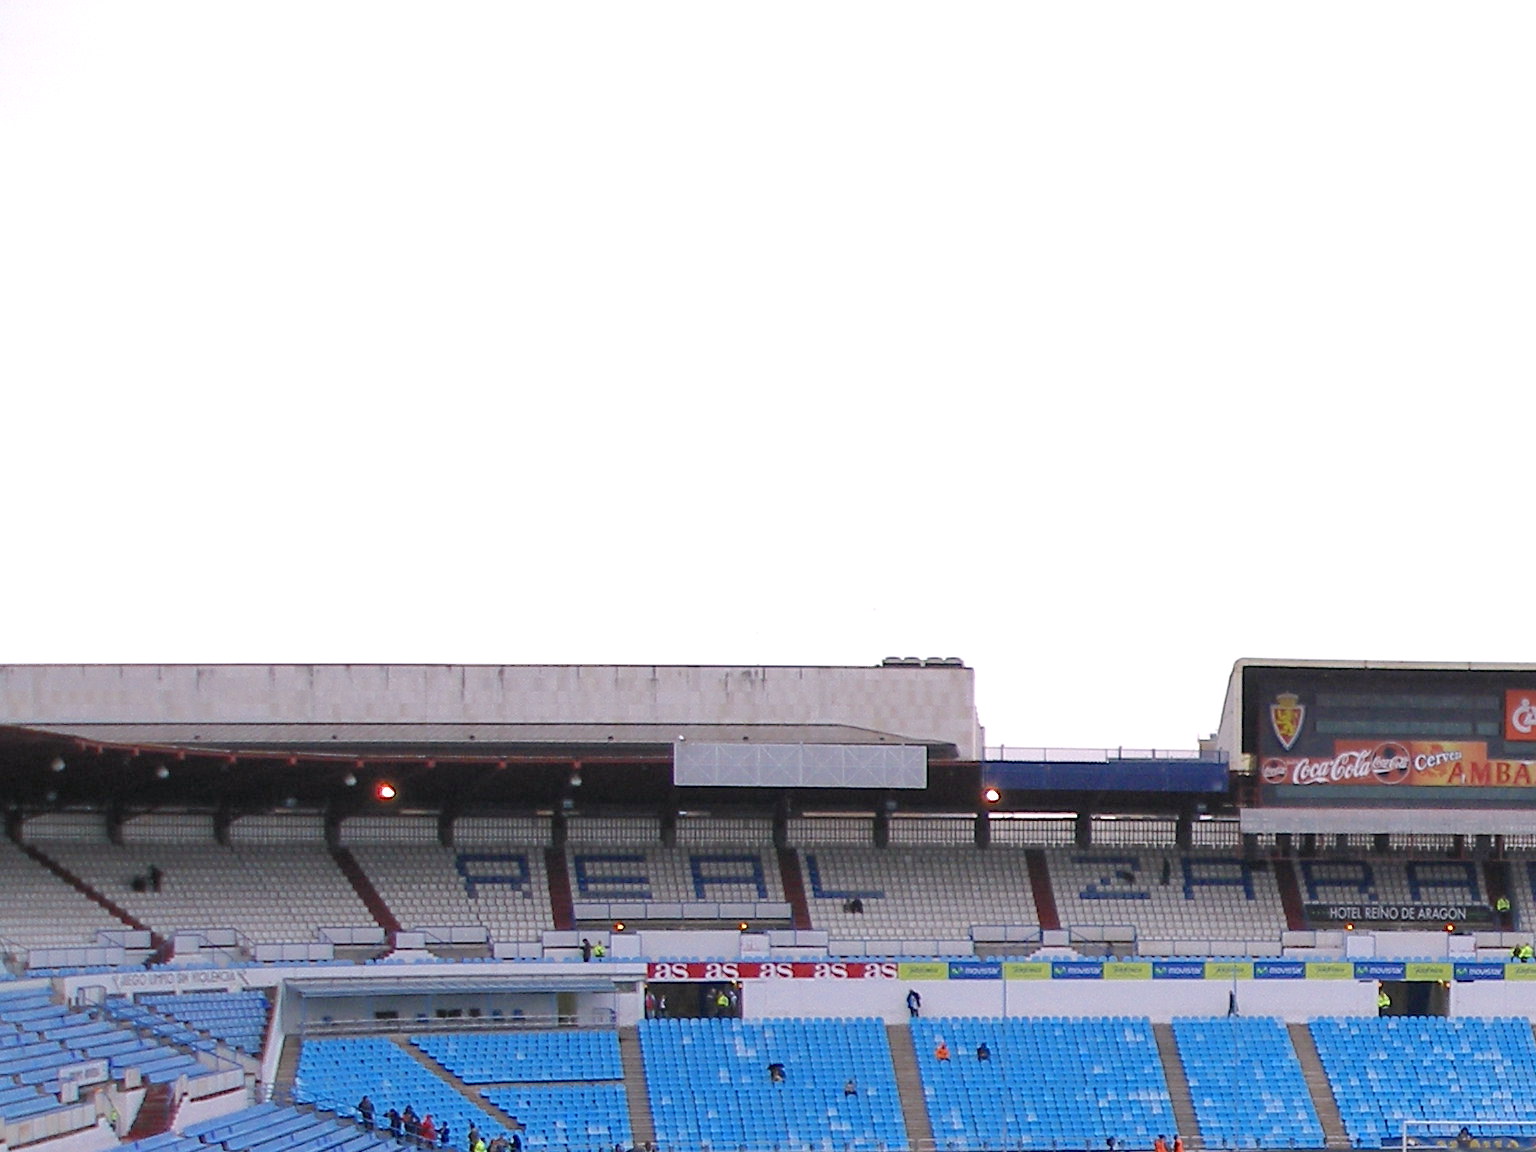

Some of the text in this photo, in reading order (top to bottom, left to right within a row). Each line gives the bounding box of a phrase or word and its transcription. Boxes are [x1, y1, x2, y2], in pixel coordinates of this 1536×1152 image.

[1292, 750, 1374, 785] Coca-Cola
[455, 854, 885, 899] REAL
[1330, 907, 1362, 920] HOTEL
[1365, 906, 1399, 920] REINO
[1401, 907, 1415, 919] DE
[654, 963, 689, 980] as
[705, 963, 740, 980] as
[759, 963, 794, 980] as
[814, 963, 849, 980] as
[864, 963, 898, 980] as
